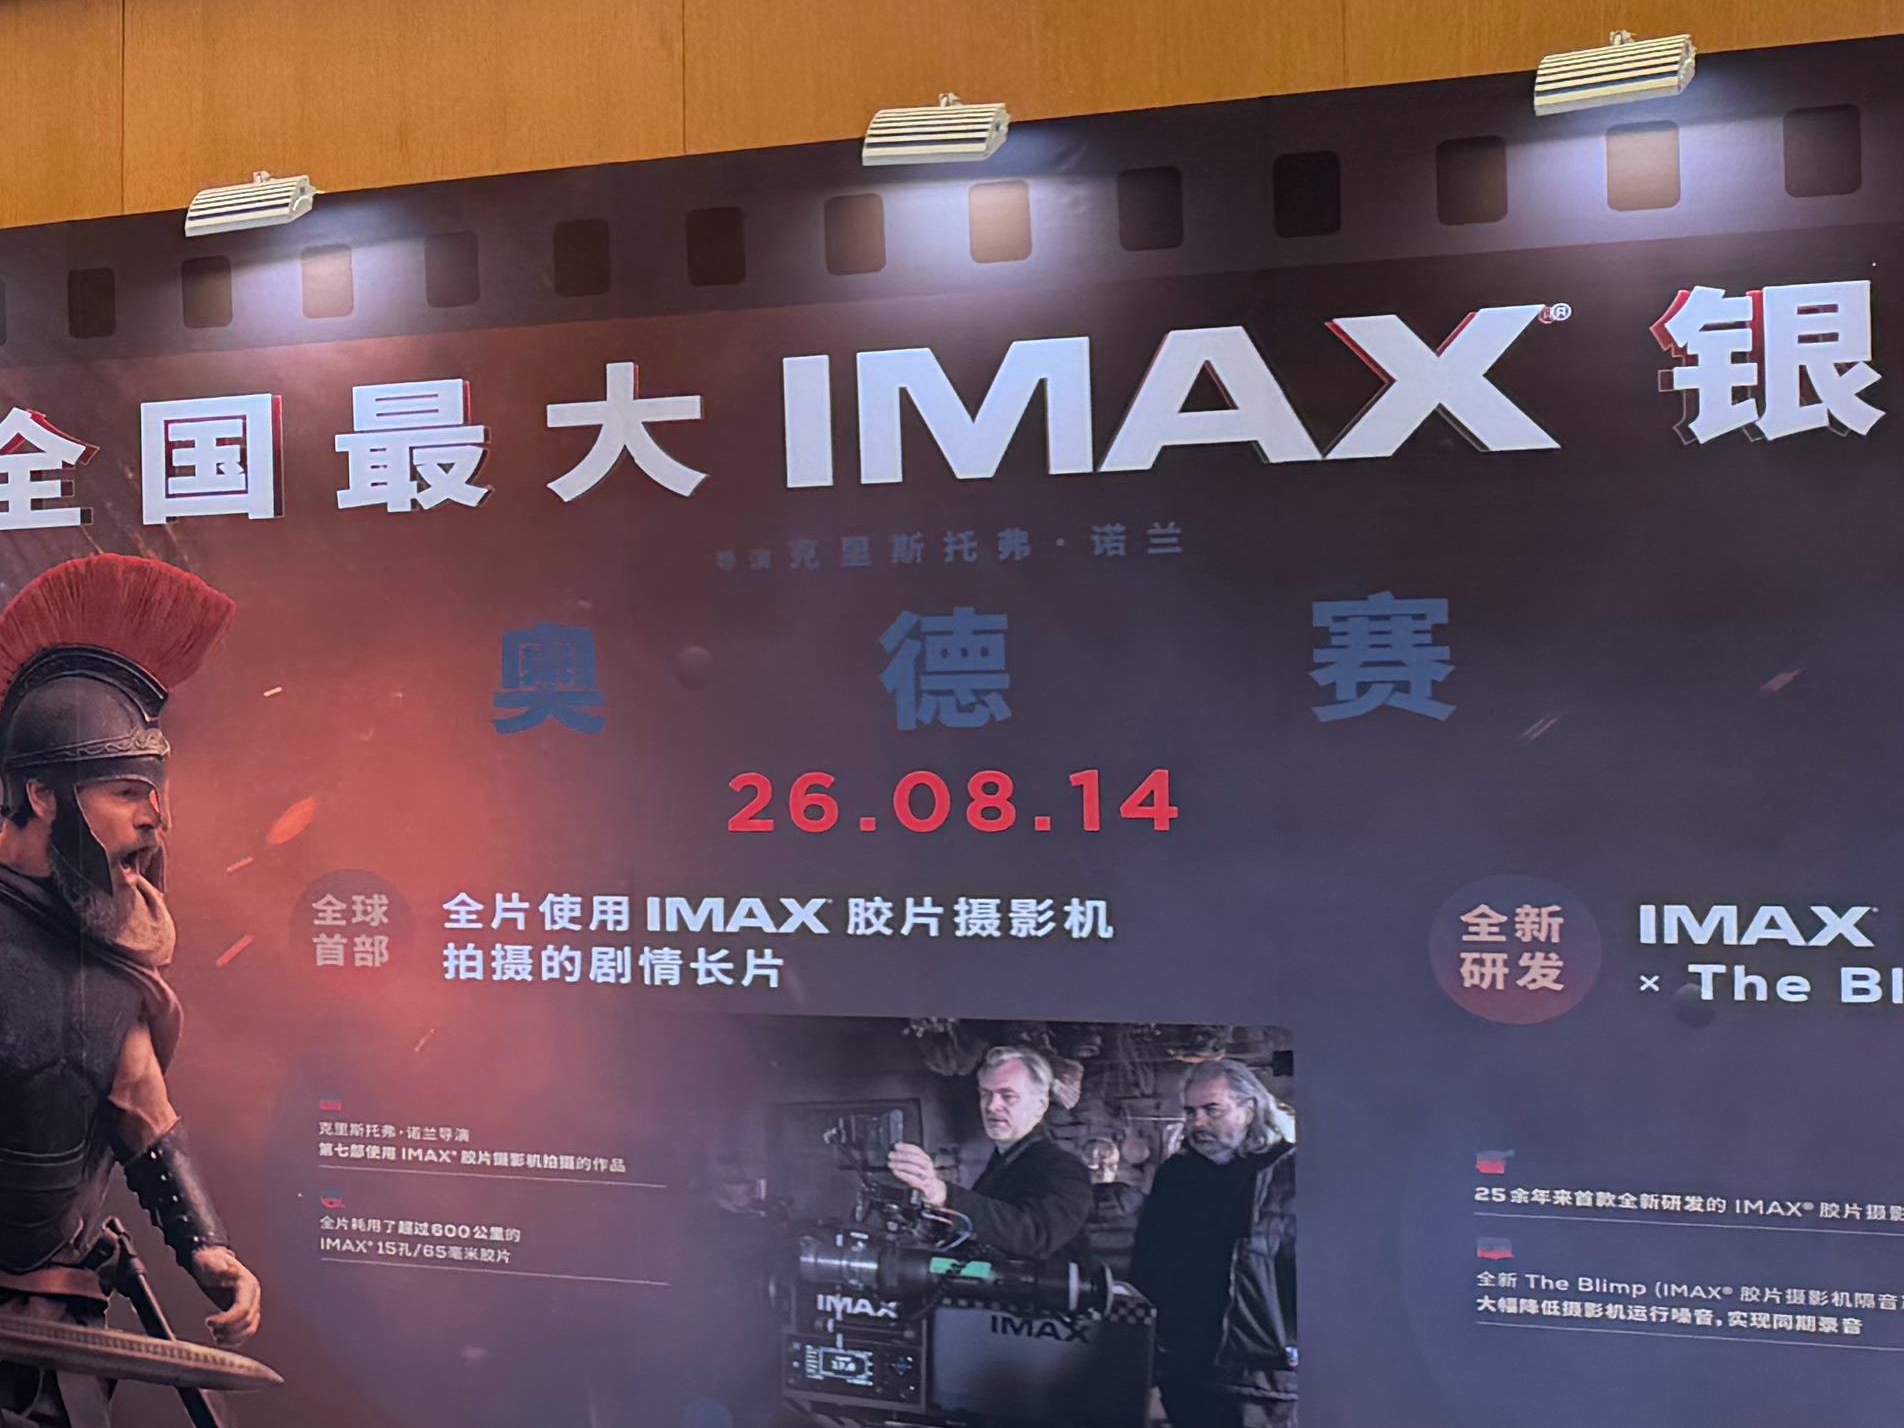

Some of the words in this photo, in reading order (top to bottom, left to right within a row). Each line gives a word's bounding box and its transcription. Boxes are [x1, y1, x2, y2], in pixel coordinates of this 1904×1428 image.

[726, 767, 1180, 834] 26.08.14
[311, 893, 390, 929] 全球
[1459, 903, 1565, 945] 全新
[311, 932, 390, 969] 首部
[442, 943, 785, 988] 拍摄的剧情长片
[1459, 950, 1566, 992] 研发
[1688, 963, 1812, 1003] The
[1476, 1270, 1518, 1289] 全新
[1524, 1273, 1570, 1292] The
[1578, 1276, 1648, 1299] Blimp
[1740, 1285, 1904, 1312] 胶片摄影机隔音
